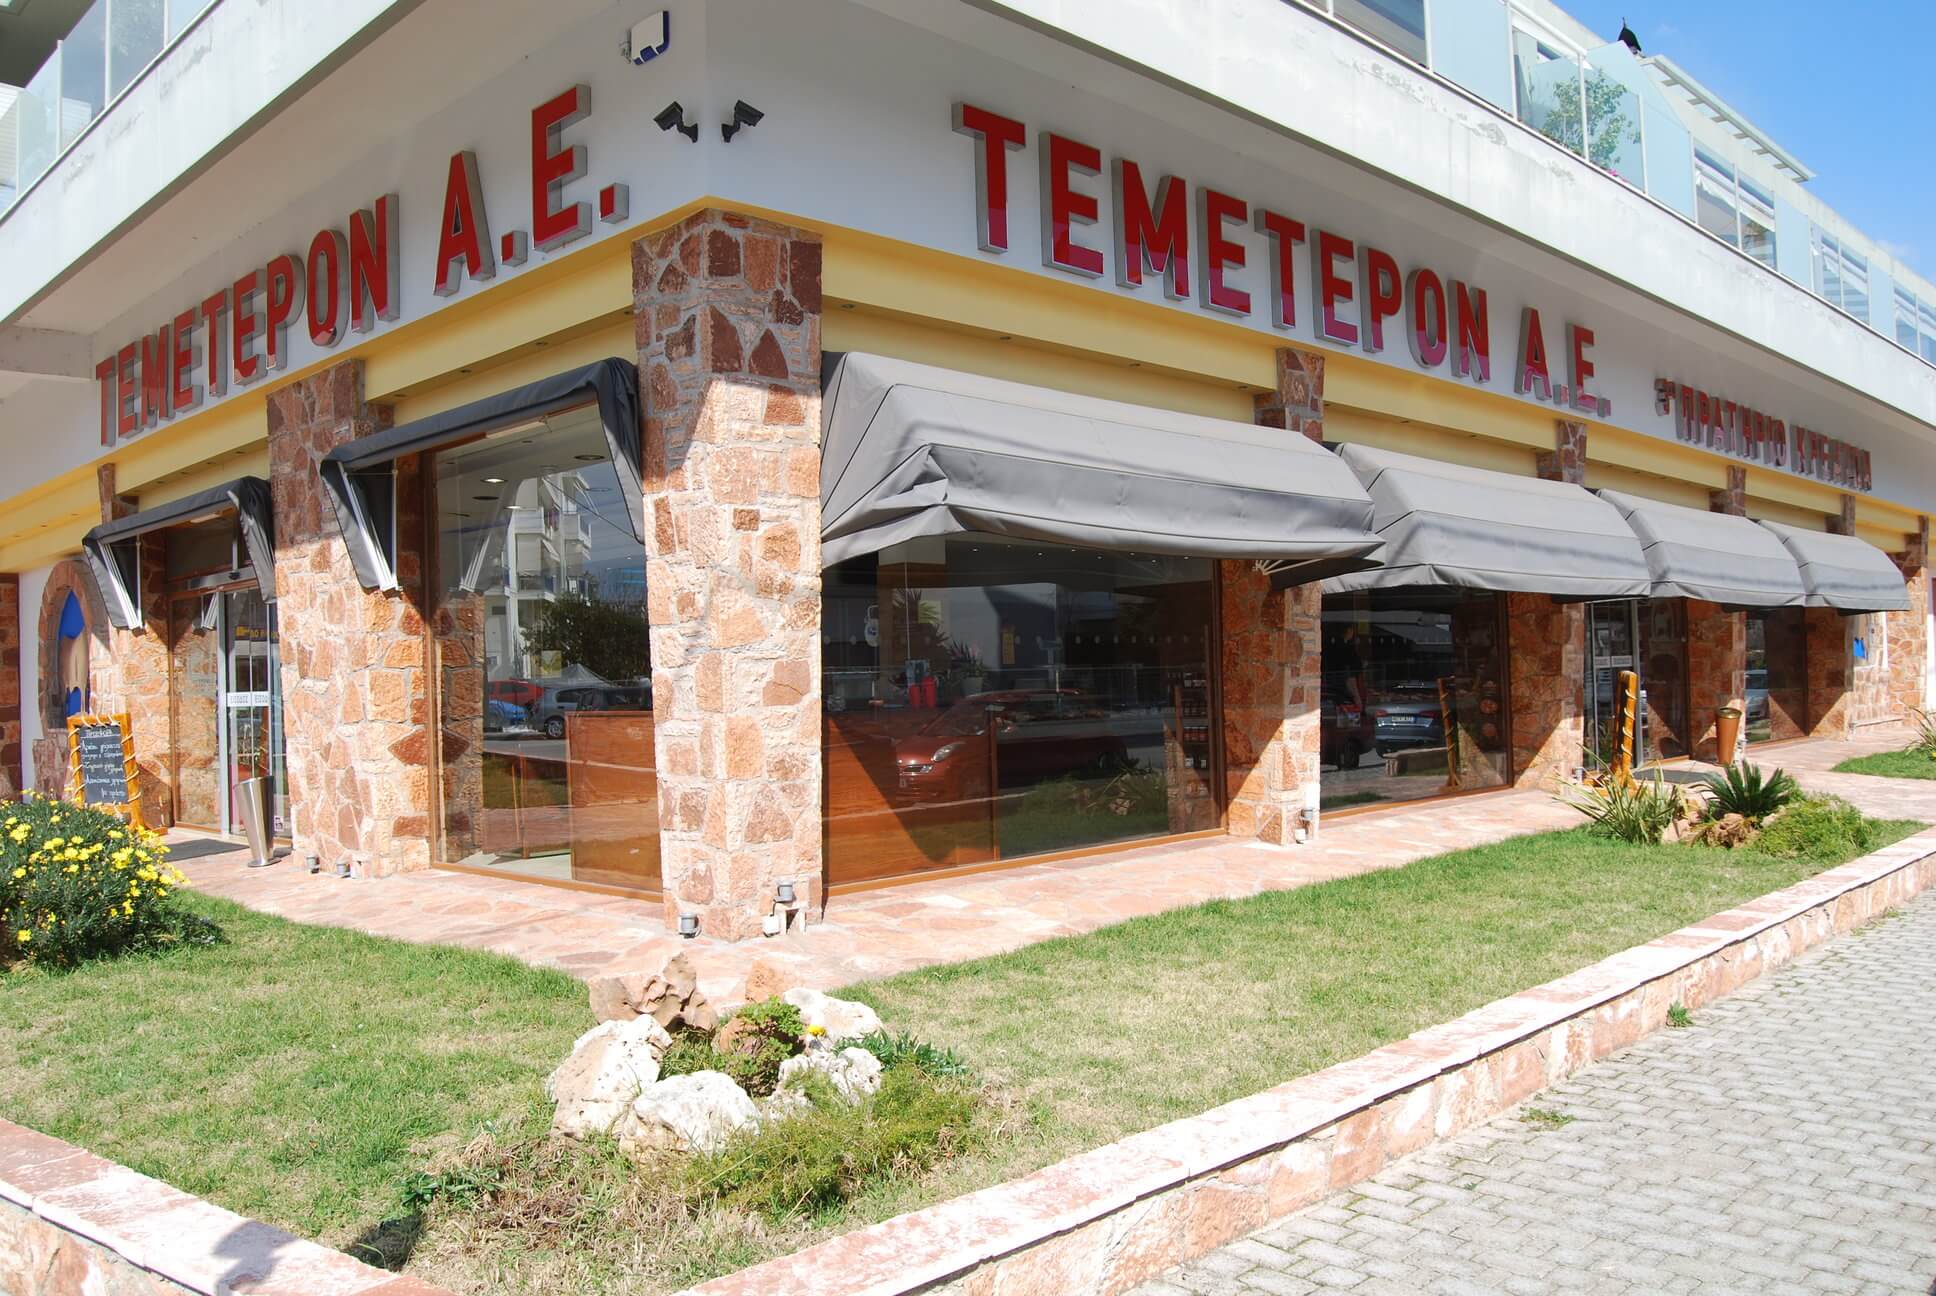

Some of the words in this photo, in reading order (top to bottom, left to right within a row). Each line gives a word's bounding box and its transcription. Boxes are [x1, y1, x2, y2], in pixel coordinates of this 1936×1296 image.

[96, 193, 400, 447] ΤΕΜΕΤΕΡΟΝ
[433, 83, 629, 297] Α.Ε.
[951, 101, 1490, 383] ΤΕΜΕΤΕΡΟΝ
[1515, 306, 1611, 418] Α.Ε.
